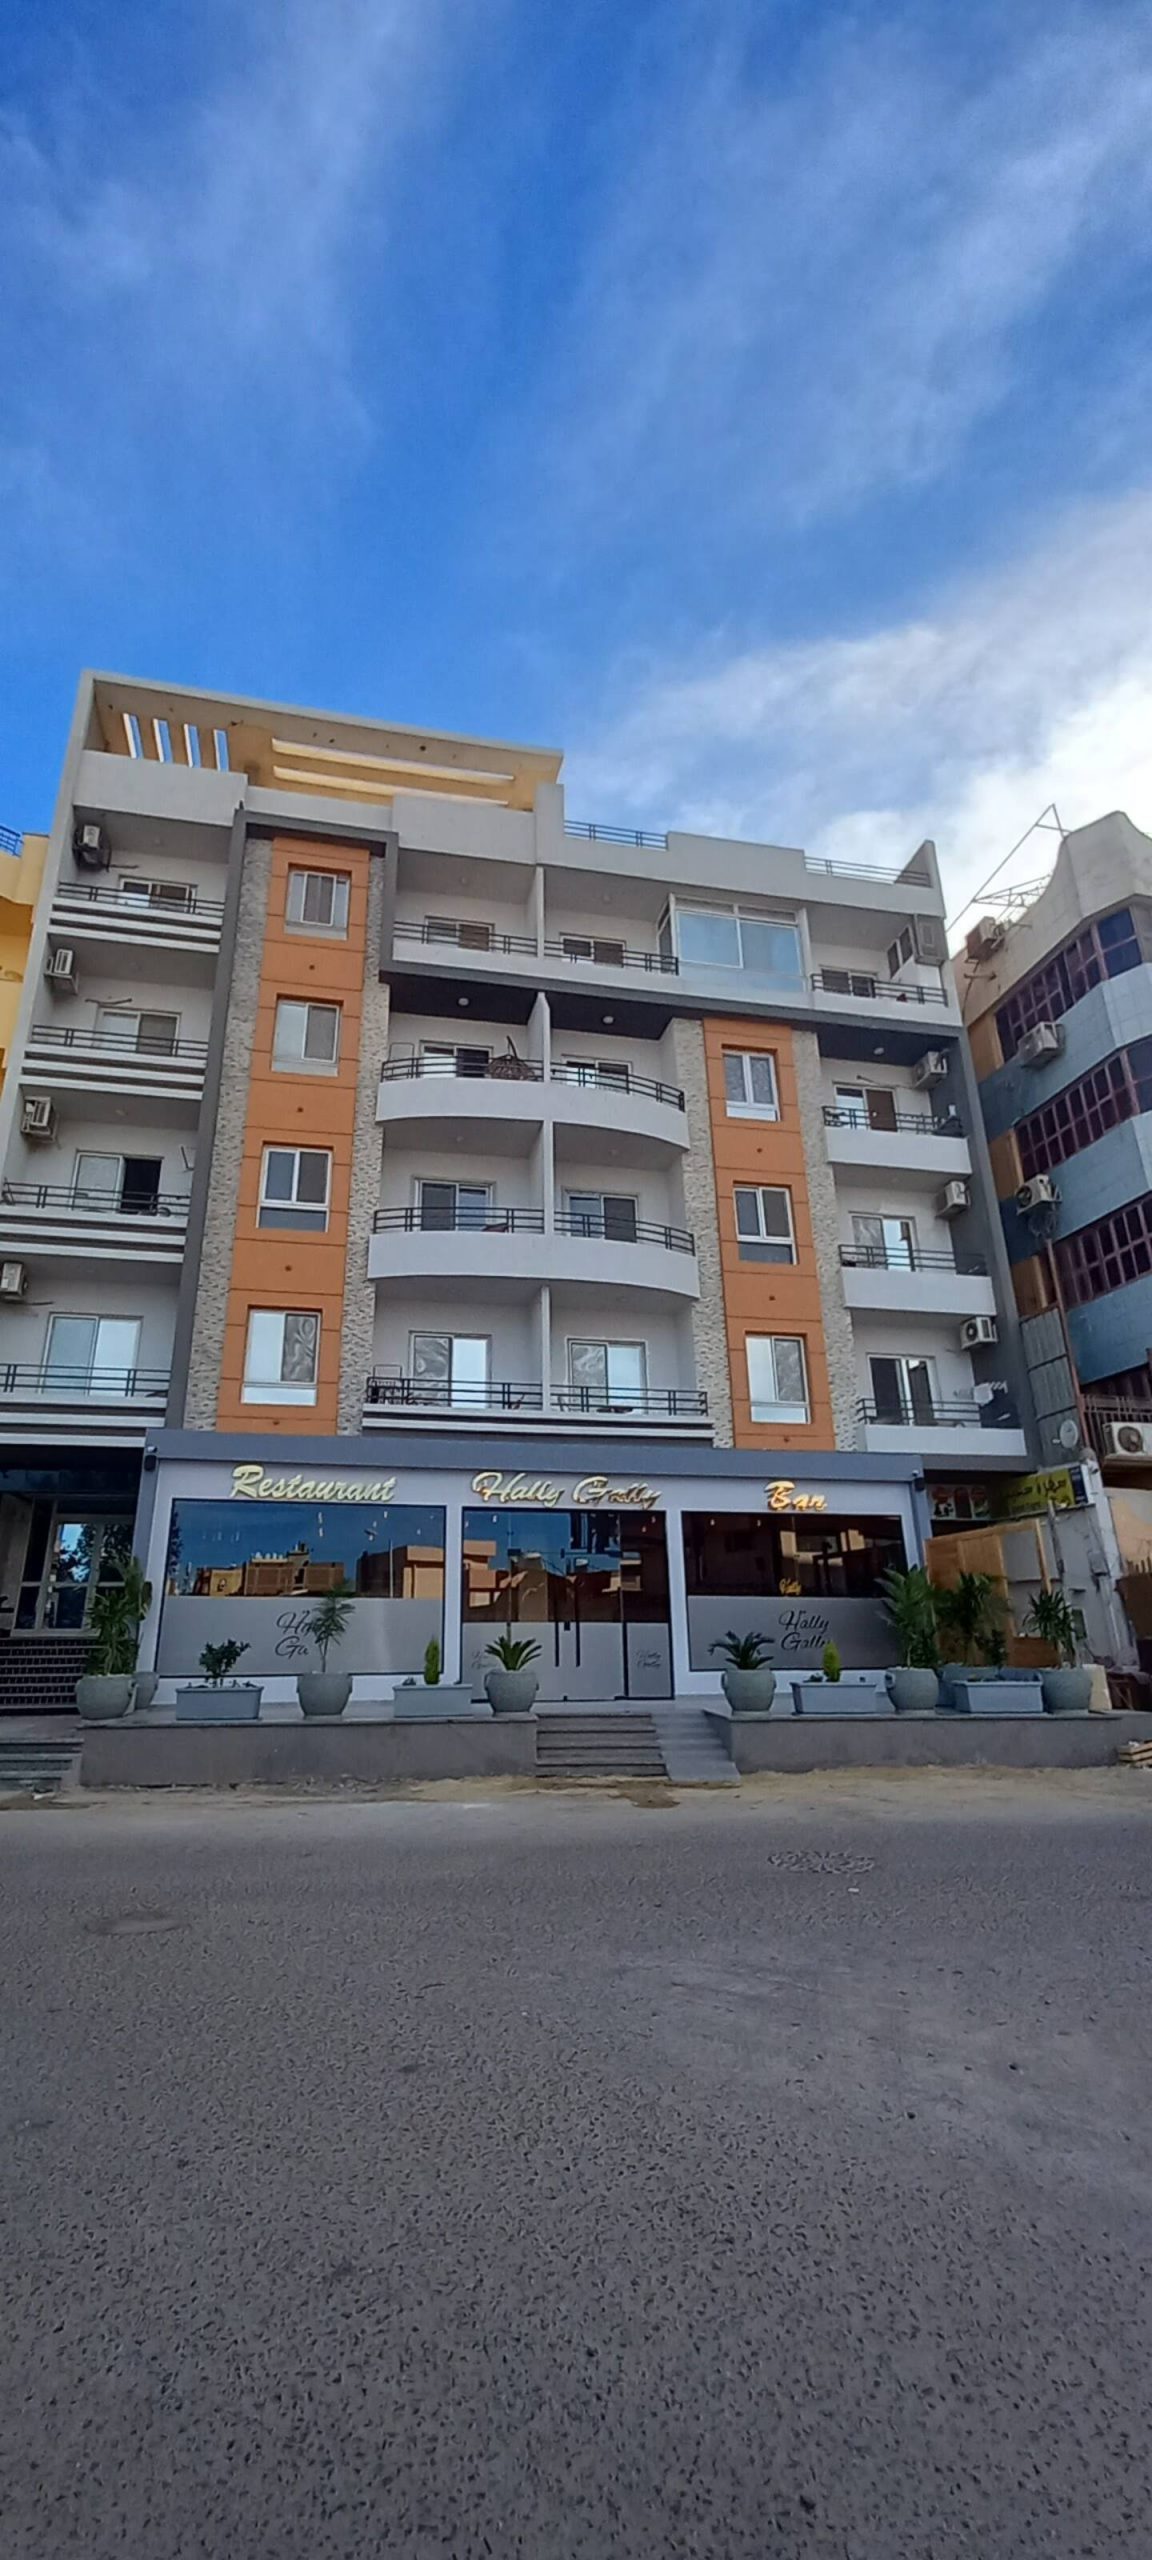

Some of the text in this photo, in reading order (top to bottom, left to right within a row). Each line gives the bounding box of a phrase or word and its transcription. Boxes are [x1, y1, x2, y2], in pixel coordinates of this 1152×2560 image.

[229, 1464, 397, 1501] Restaurant
[472, 1471, 565, 1508] Hally
[778, 1609, 830, 1634] Hally
